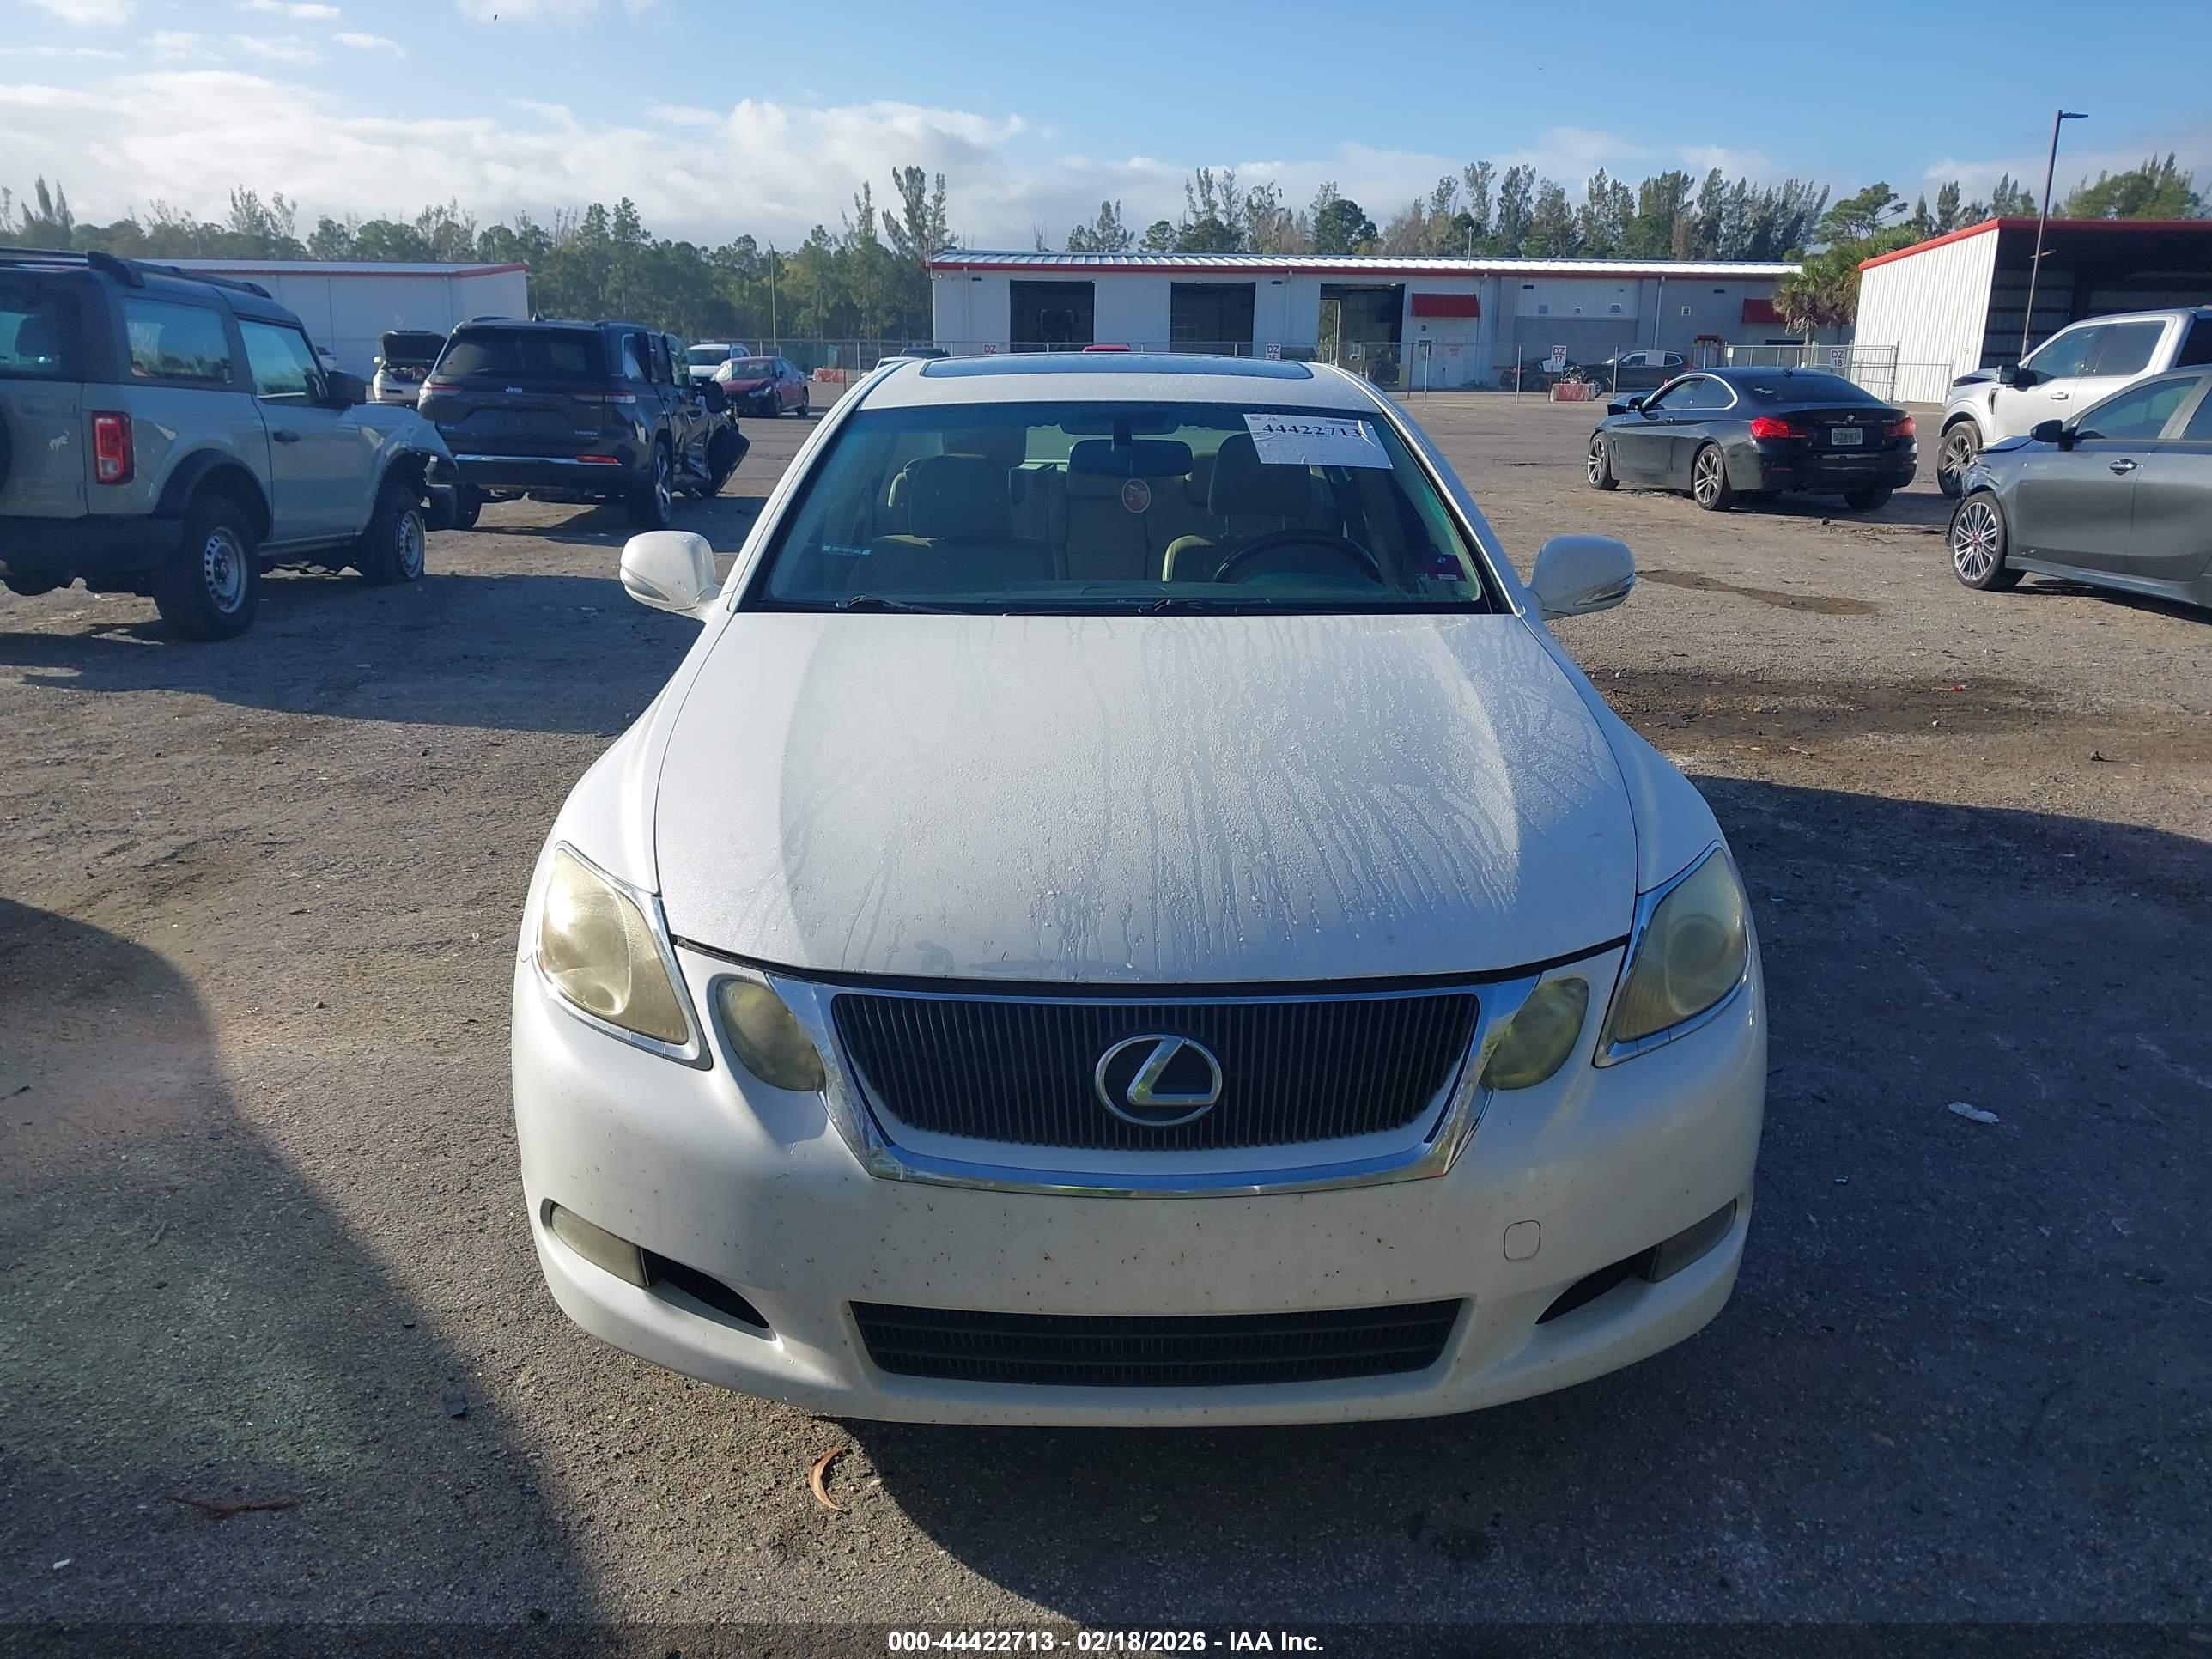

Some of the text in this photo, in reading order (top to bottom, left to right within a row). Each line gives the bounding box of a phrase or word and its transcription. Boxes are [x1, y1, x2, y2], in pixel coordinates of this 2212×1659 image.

[984, 344, 997, 354] DZ
[1267, 344, 1279, 354] DZ
[1553, 346, 1566, 356] DZ
[1831, 349, 1844, 359] DZ
[1554, 356, 1563, 365] 17
[1834, 359, 1843, 368] 18
[1261, 423, 1363, 438] 44422713
